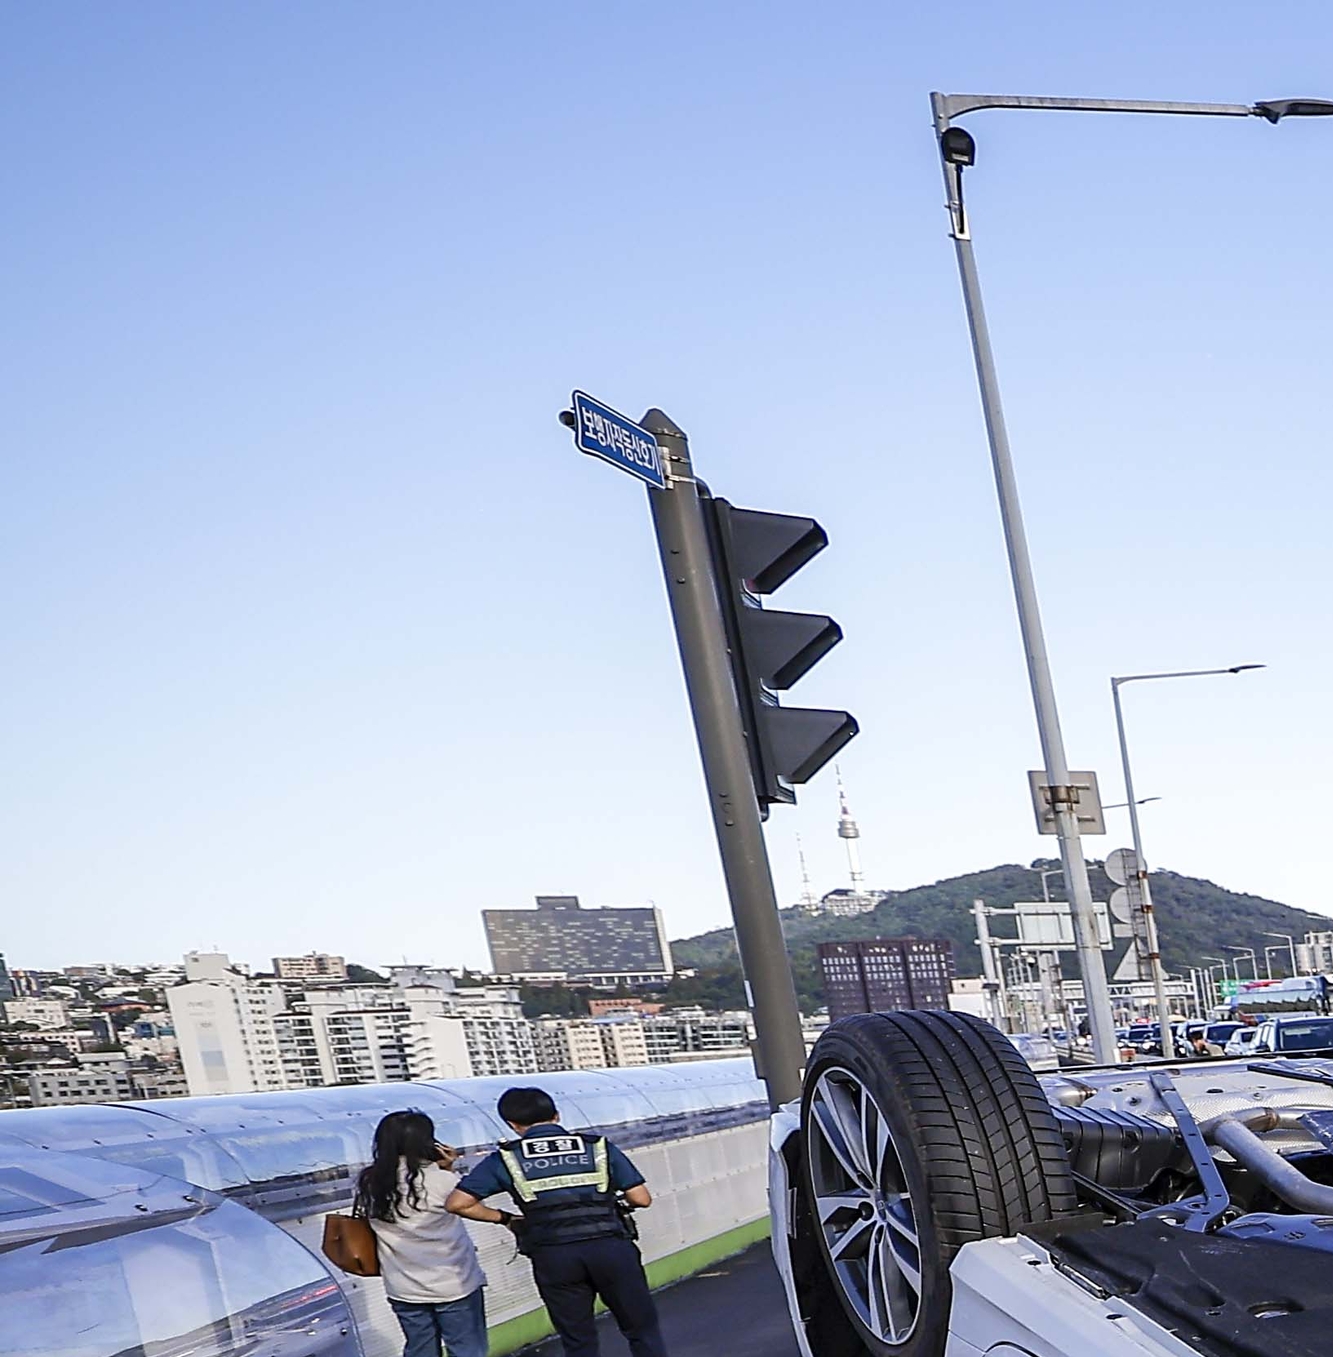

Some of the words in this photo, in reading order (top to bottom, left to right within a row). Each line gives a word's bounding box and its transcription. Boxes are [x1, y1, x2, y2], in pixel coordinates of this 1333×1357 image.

[582, 406, 661, 476] 보행자작동신호기
[532, 1139, 574, 1153] 경찰
[522, 1154, 590, 1173] POLICE
